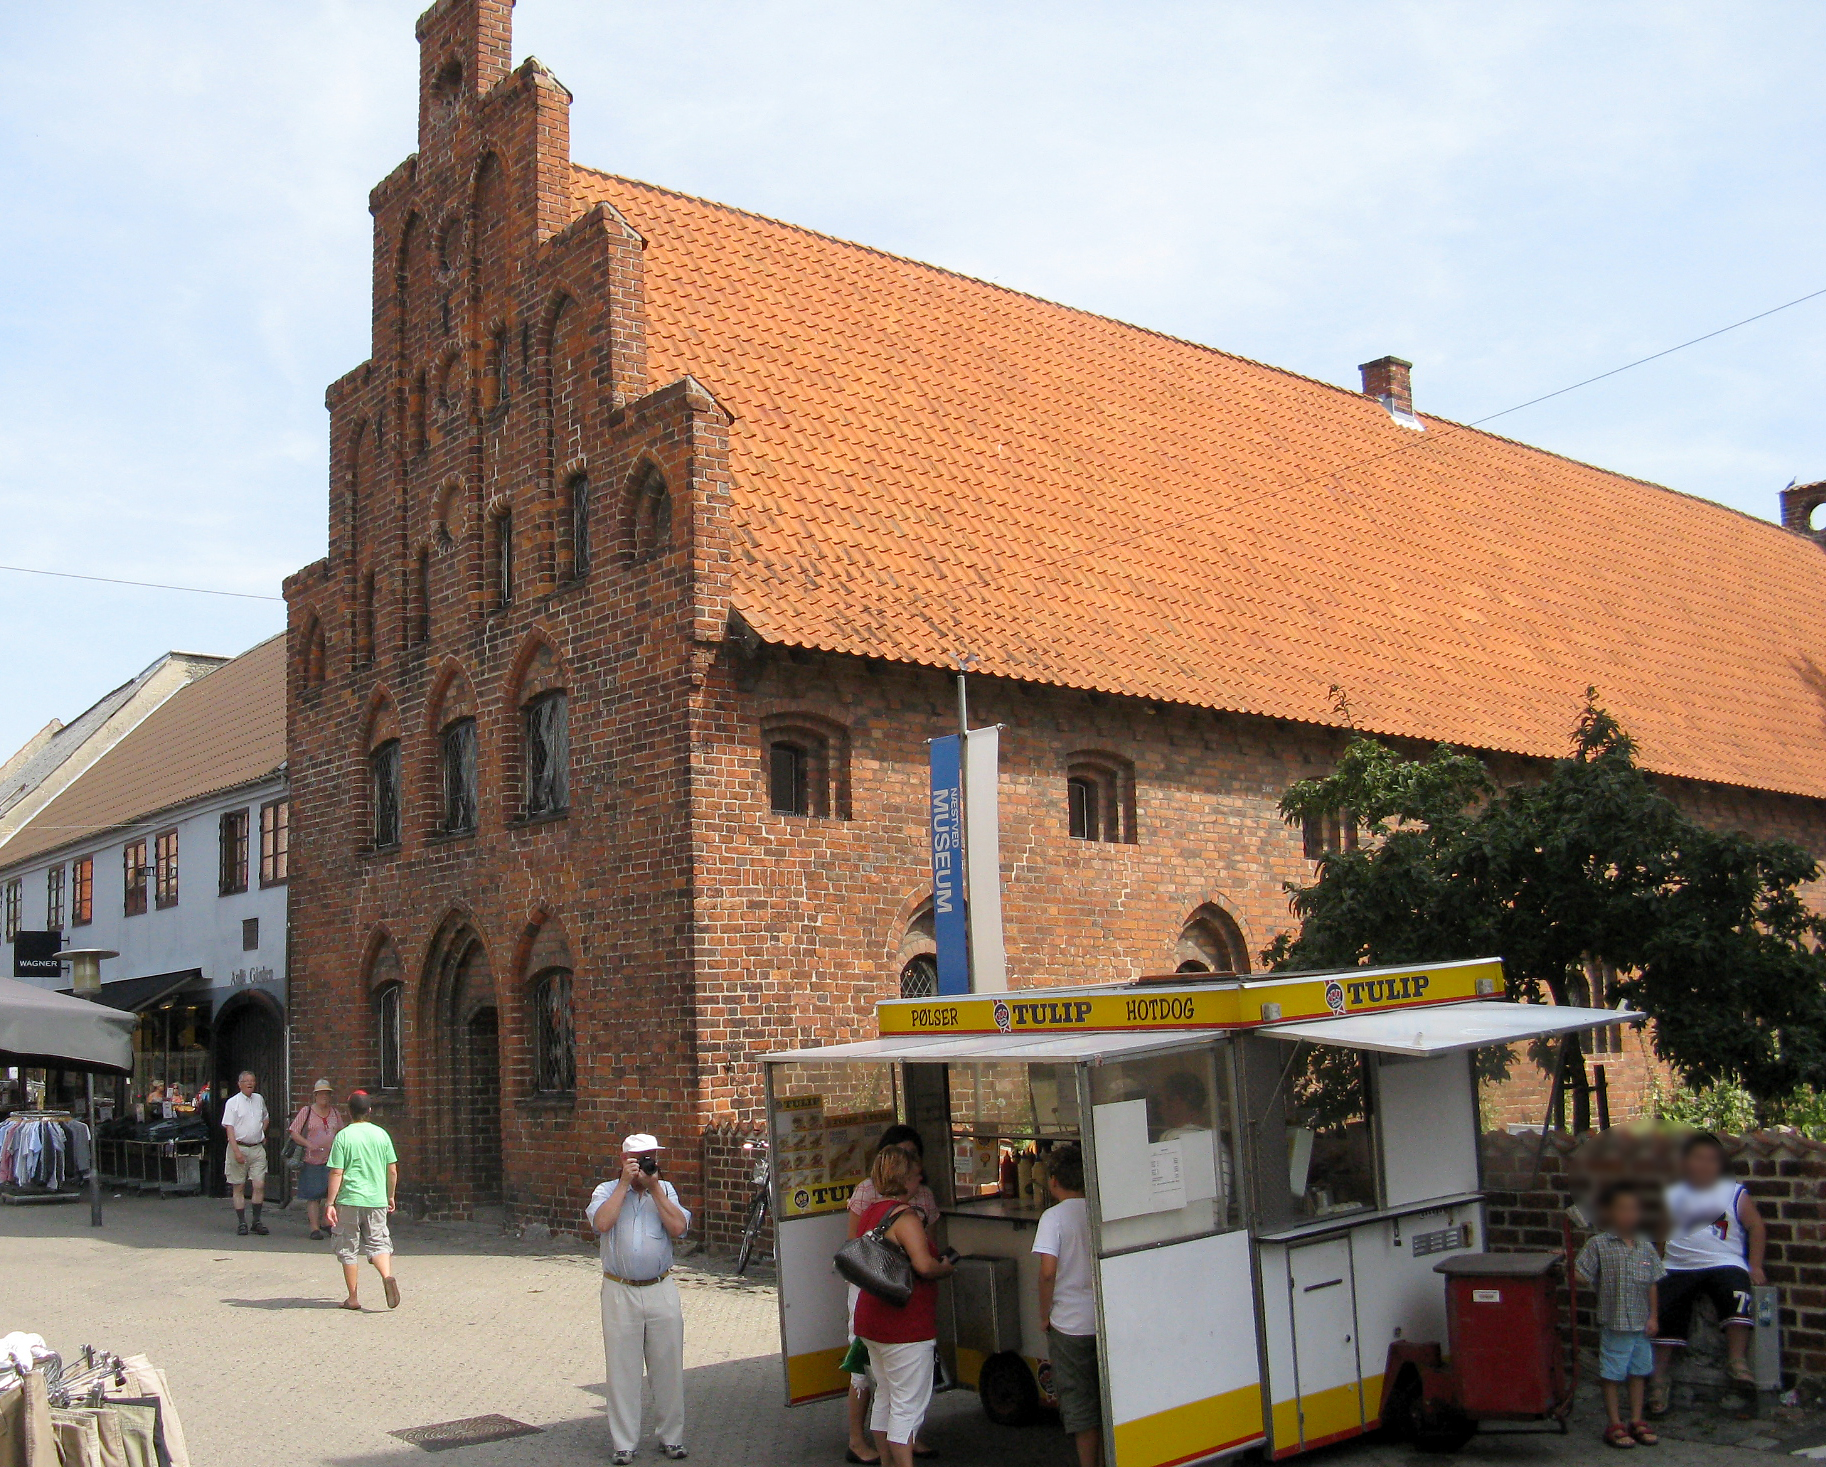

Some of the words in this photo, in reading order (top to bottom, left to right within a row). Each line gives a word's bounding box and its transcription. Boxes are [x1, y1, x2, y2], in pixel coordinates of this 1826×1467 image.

[950, 787, 960, 848] NÆSTVED
[933, 788, 953, 913] MUSEUM
[1347, 975, 1429, 1004] TULIP
[911, 1008, 959, 1026] PØLSER
[1012, 1001, 1092, 1025] TULIP
[1126, 997, 1195, 1021] HOTDOG
[812, 1184, 856, 1204] TUL
